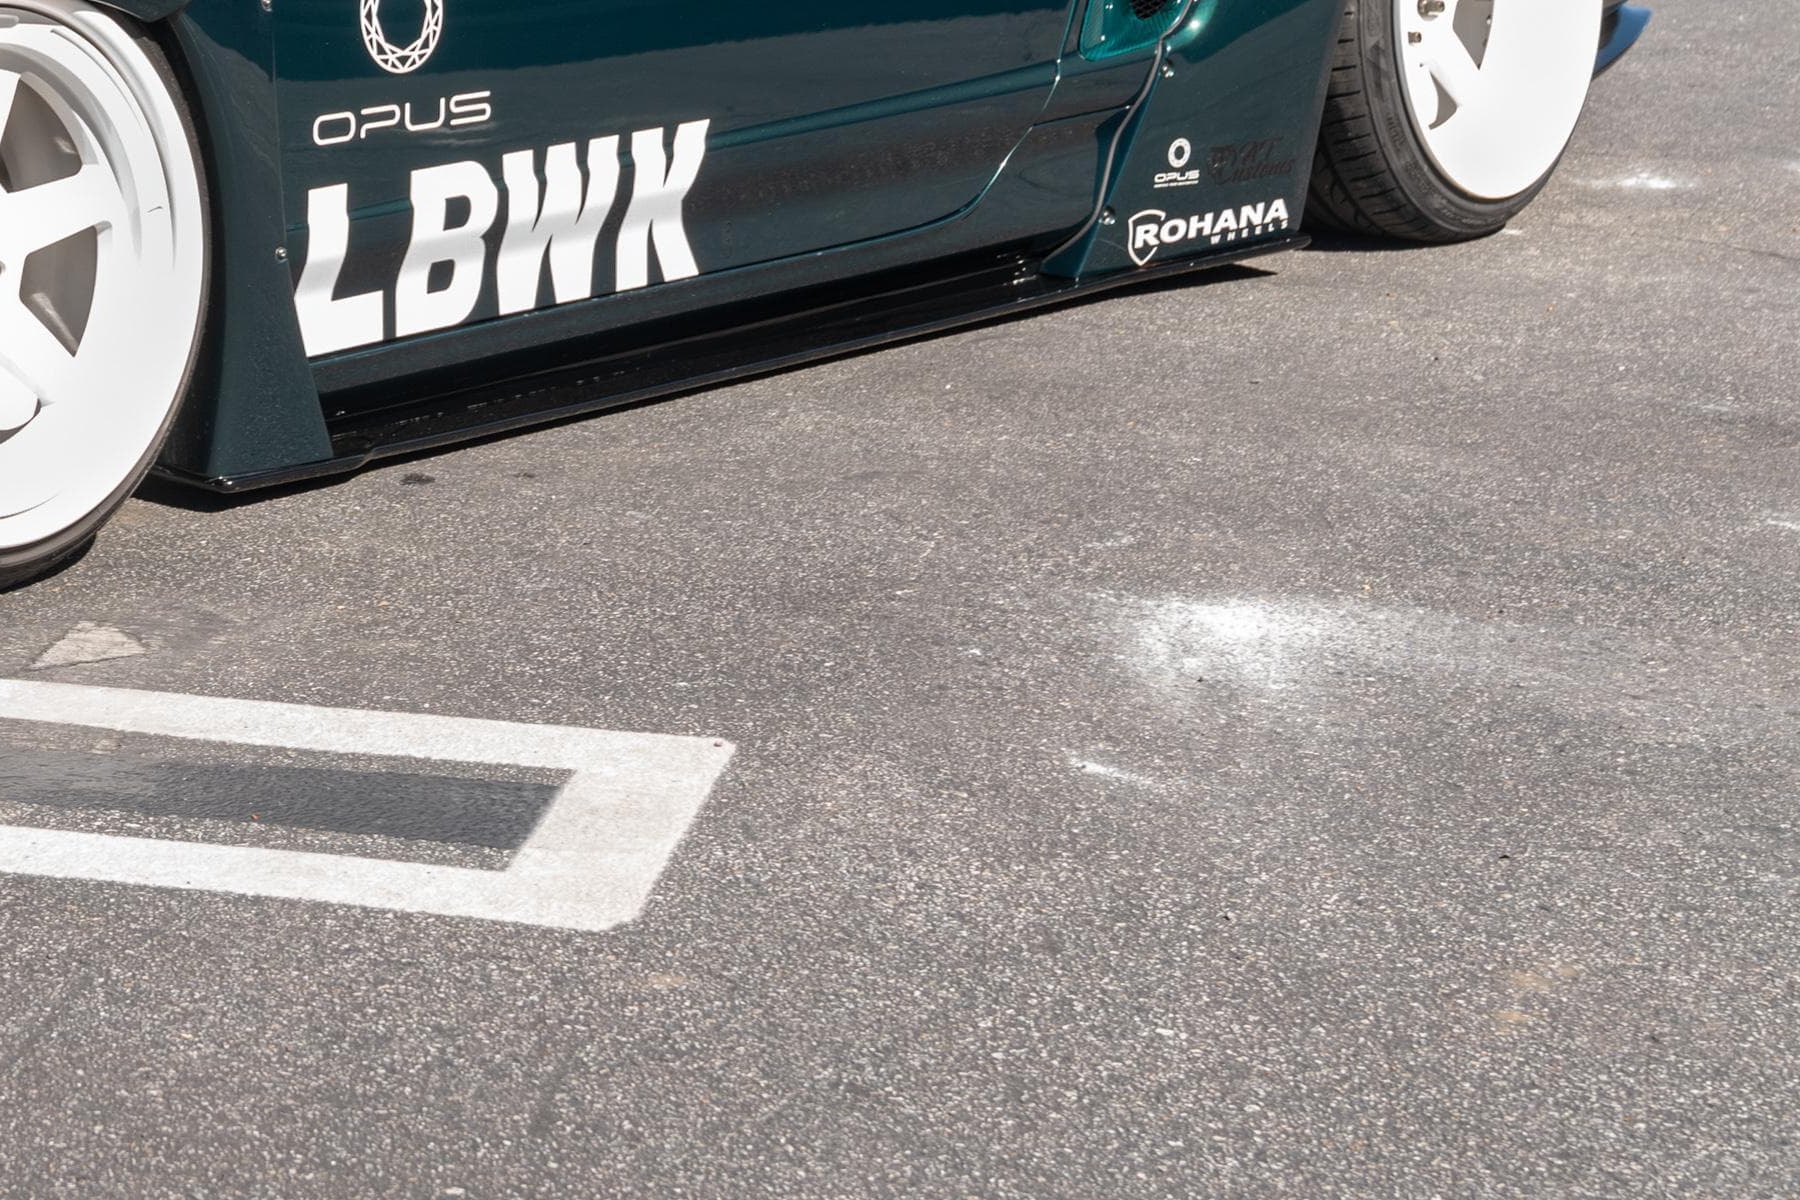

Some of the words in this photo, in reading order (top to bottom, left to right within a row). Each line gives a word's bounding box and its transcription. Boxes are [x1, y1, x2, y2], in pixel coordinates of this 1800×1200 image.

[312, 90, 492, 146] OPUS
[1153, 169, 1200, 183] OPUS
[293, 118, 711, 358] LBWK
[1134, 198, 1289, 249] ROHANA
[1210, 219, 1289, 245] WHEELS
